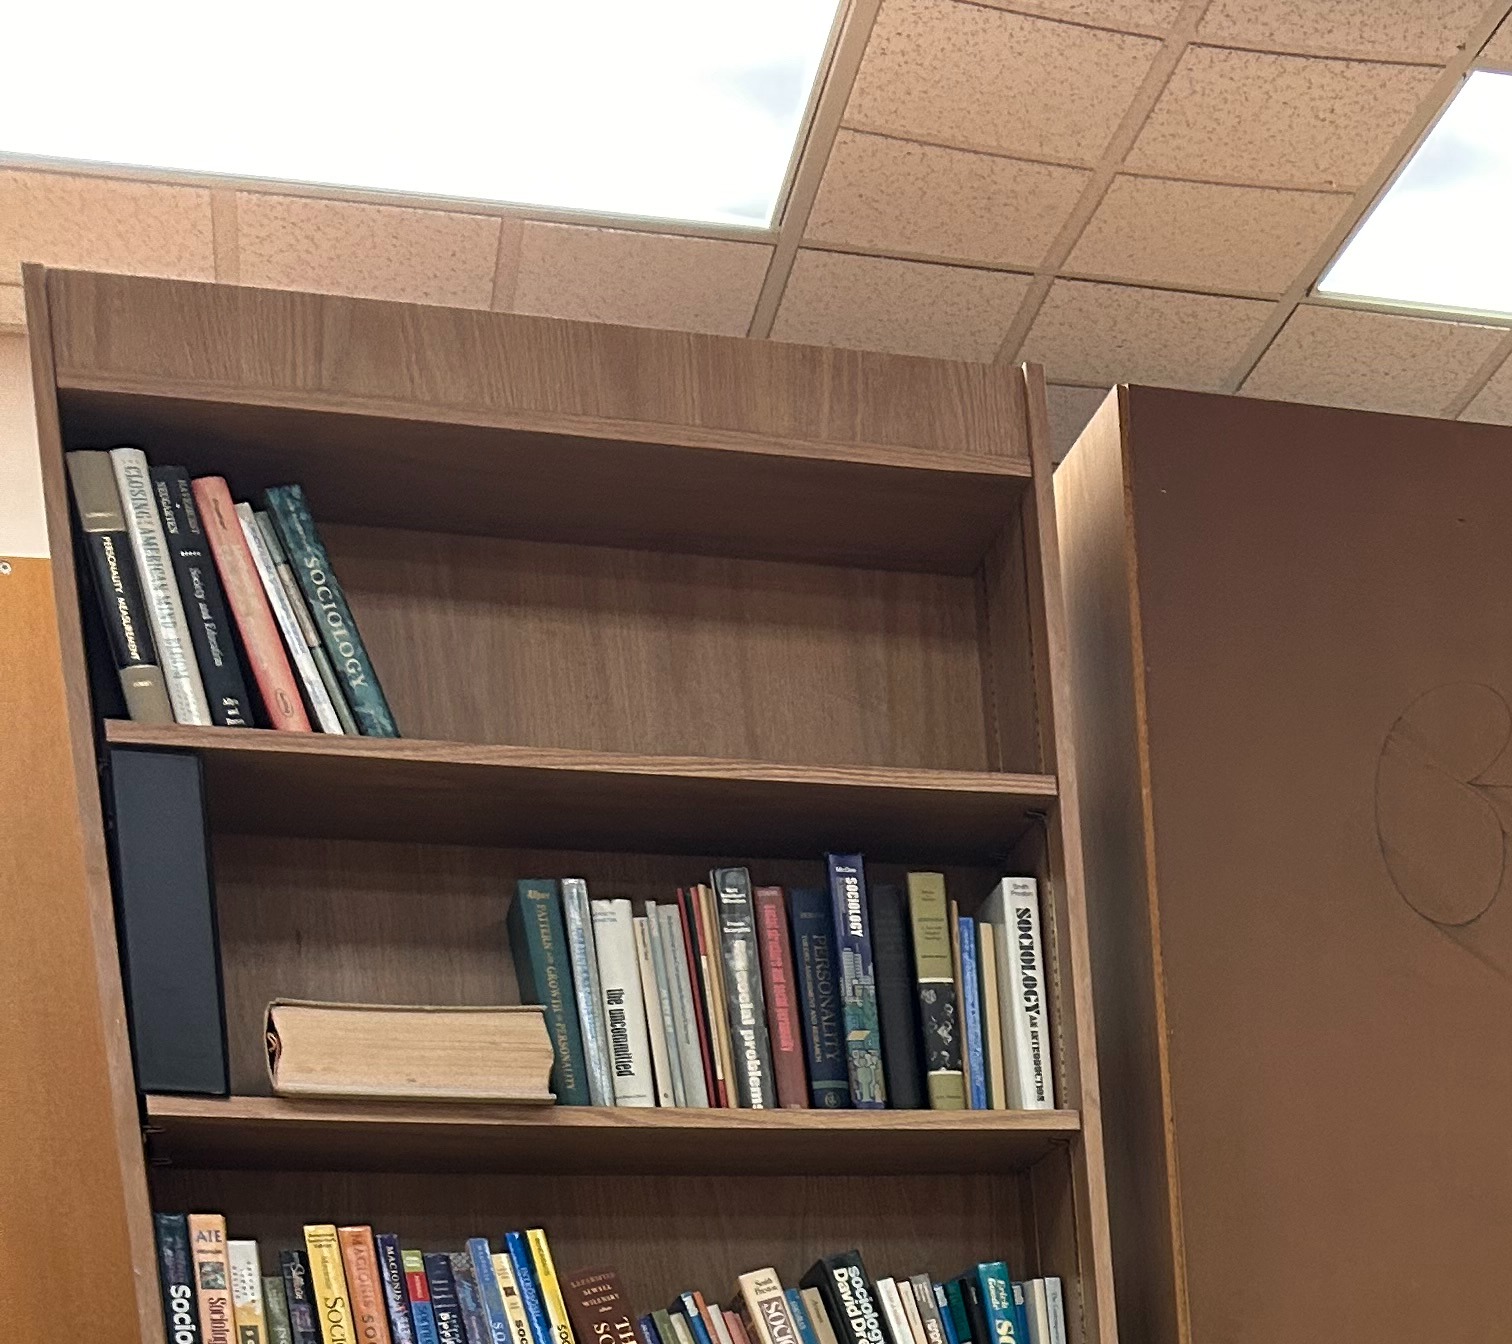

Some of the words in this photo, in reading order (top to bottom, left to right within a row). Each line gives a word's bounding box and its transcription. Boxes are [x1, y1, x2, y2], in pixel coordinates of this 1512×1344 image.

[124, 463, 151, 519] CLOSING
[101, 535, 124, 594] PERSONALITY
[116, 595, 140, 662] MEASUREMENT
[198, 601, 212, 620] and
[303, 553, 367, 690] SOCIOLOGY
[845, 876, 864, 937] SOCIOLOGY
[537, 903, 552, 949] PATTERN
[546, 965, 562, 1012] GROWTH
[1015, 906, 1040, 1015] SOCIOLOGY
[606, 988, 625, 1005] the
[813, 933, 840, 1063] PERSONALITY
[608, 1007, 634, 1077] uncommitted
[196, 1229, 222, 1243] AIE
[349, 1233, 373, 1308] MACIONIS
[385, 1246, 402, 1301] MACIONIS
[833, 1266, 862, 1319] David
[996, 1278, 1009, 1309] Erich
